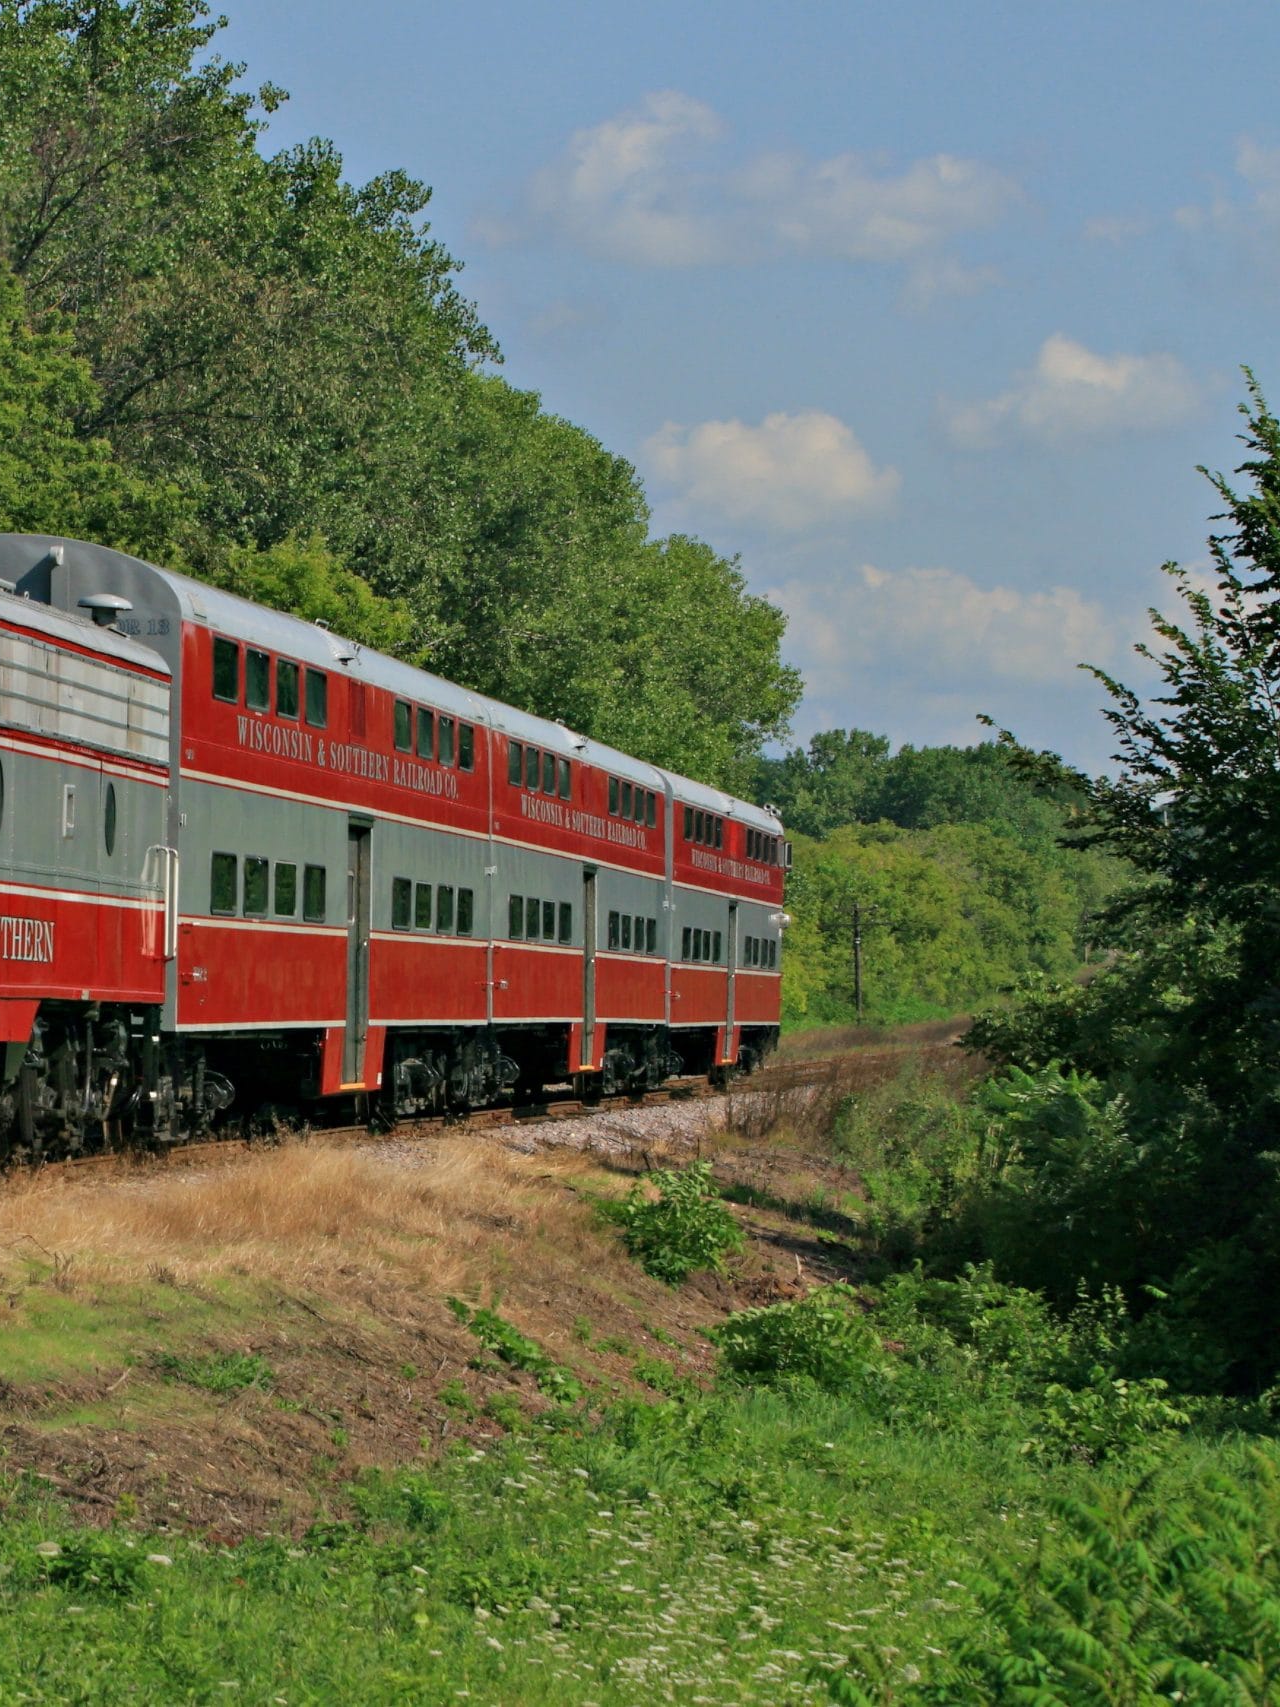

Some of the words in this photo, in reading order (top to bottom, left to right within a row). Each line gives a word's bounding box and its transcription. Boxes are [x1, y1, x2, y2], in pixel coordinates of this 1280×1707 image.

[237, 715, 313, 762] WISCONSIN
[317, 739, 326, 767] &
[330, 742, 389, 783] SOUTHERN
[393, 759, 443, 796] RAILROAD
[445, 773, 459, 800] CO.
[521, 793, 563, 826] WISCONSIN
[565, 808, 571, 829] &
[572, 810, 606, 839] SOUTHERN
[607, 821, 637, 847] RAILROAD
